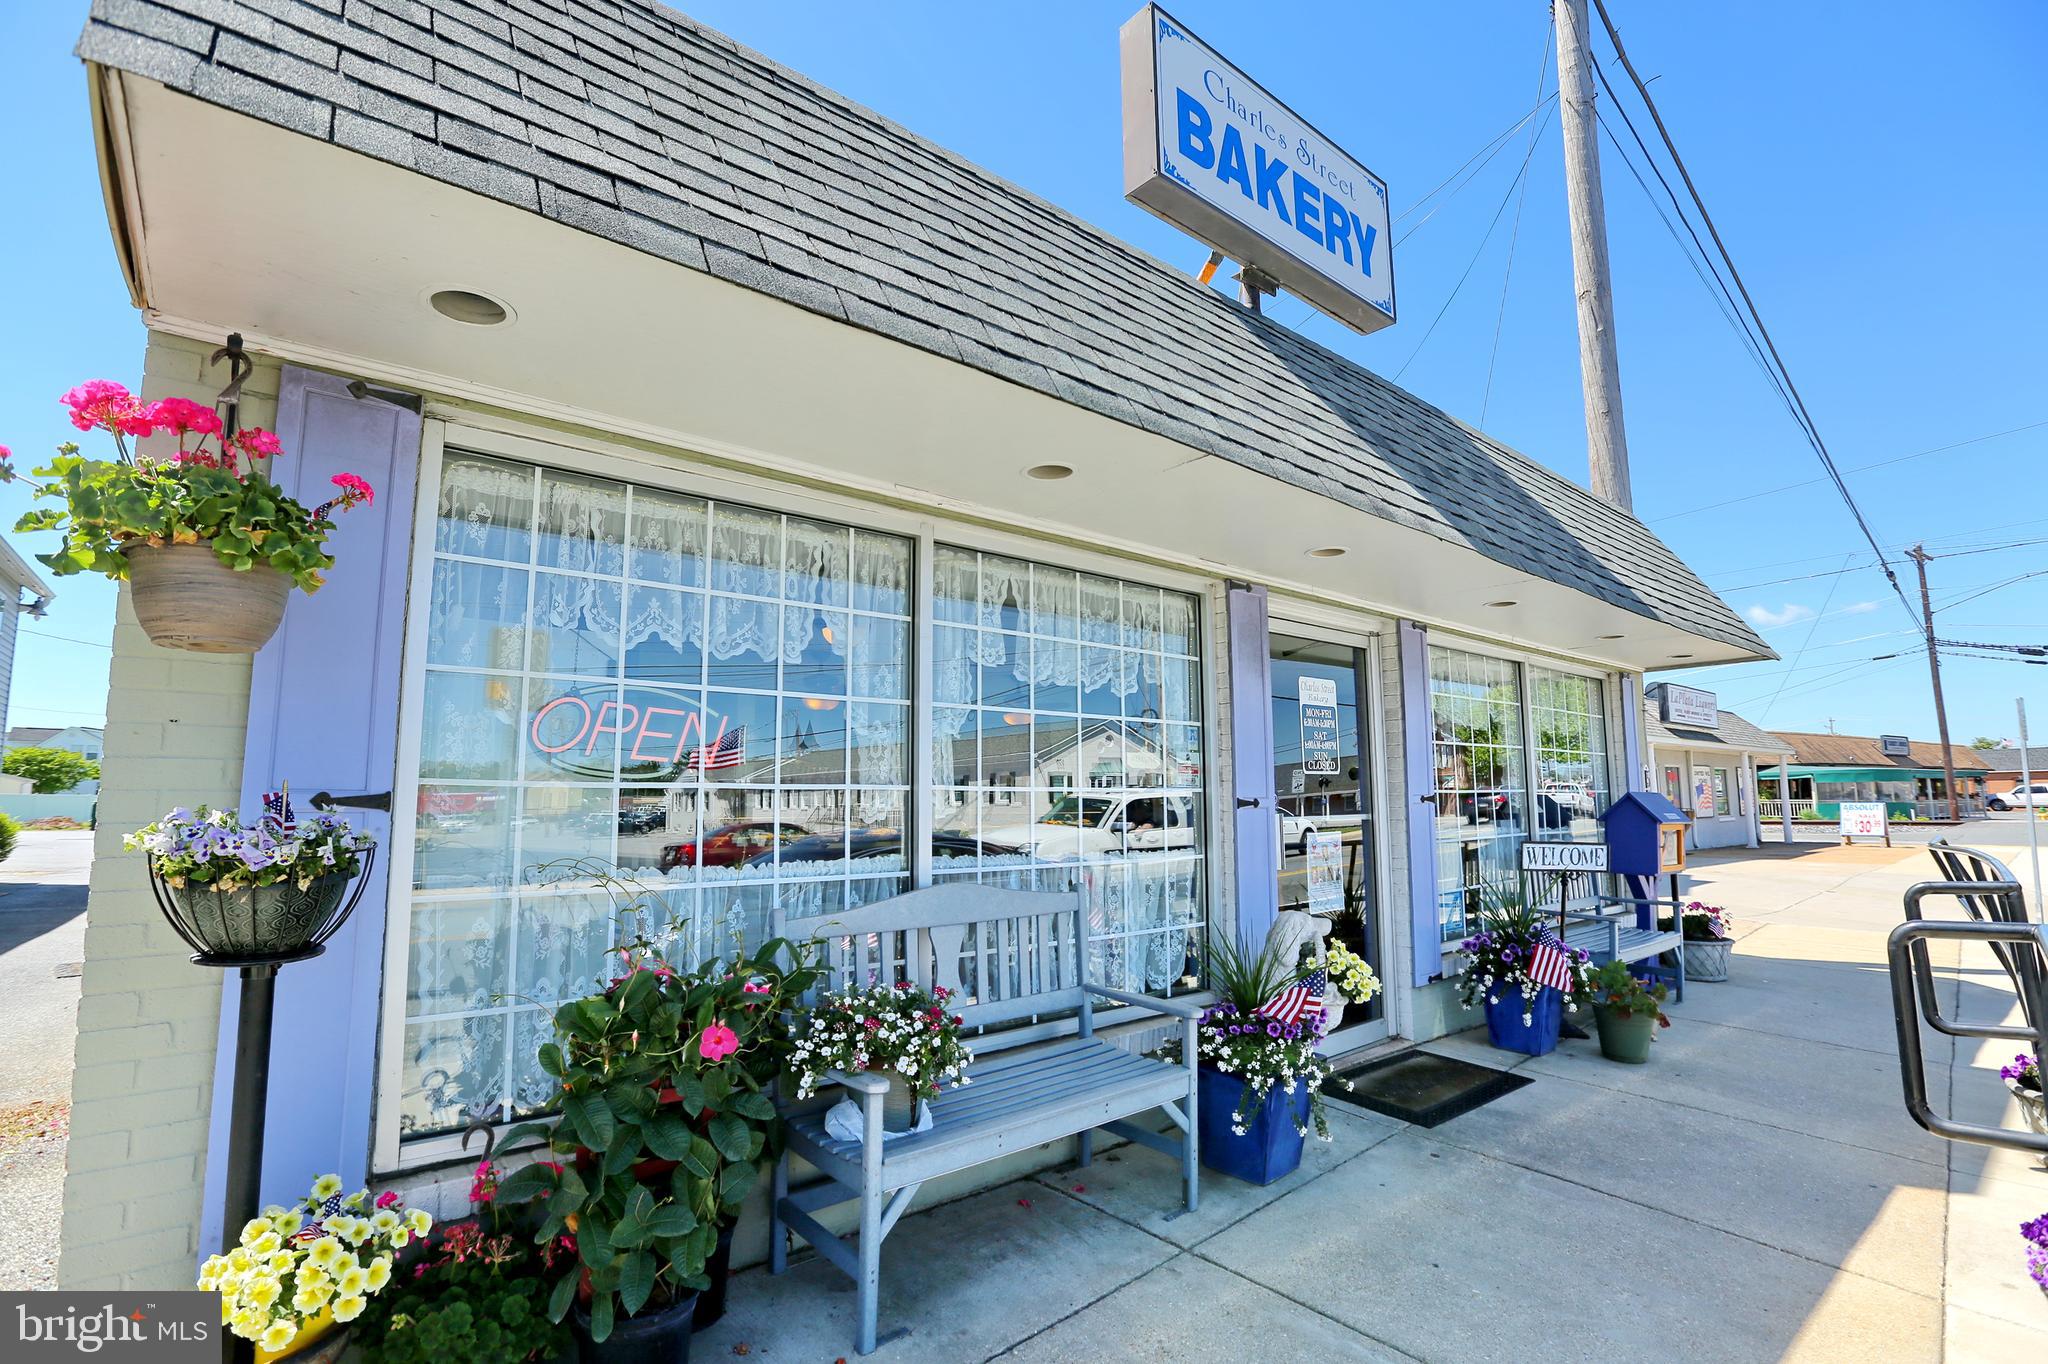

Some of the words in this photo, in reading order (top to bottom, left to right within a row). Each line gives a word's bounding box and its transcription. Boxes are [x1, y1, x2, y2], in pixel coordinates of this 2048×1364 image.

[1203, 69, 1288, 150] Charles
[1296, 138, 1357, 202] Street
[1176, 86, 1377, 279] BAKERY
[1305, 707, 1332, 718] MON-FRI
[531, 696, 729, 765] OPEN
[1313, 730, 1328, 741] SAT
[1313, 751, 1328, 761] SUN
[1307, 760, 1336, 771] CLOSED
[1526, 846, 1605, 867] WELCOME
